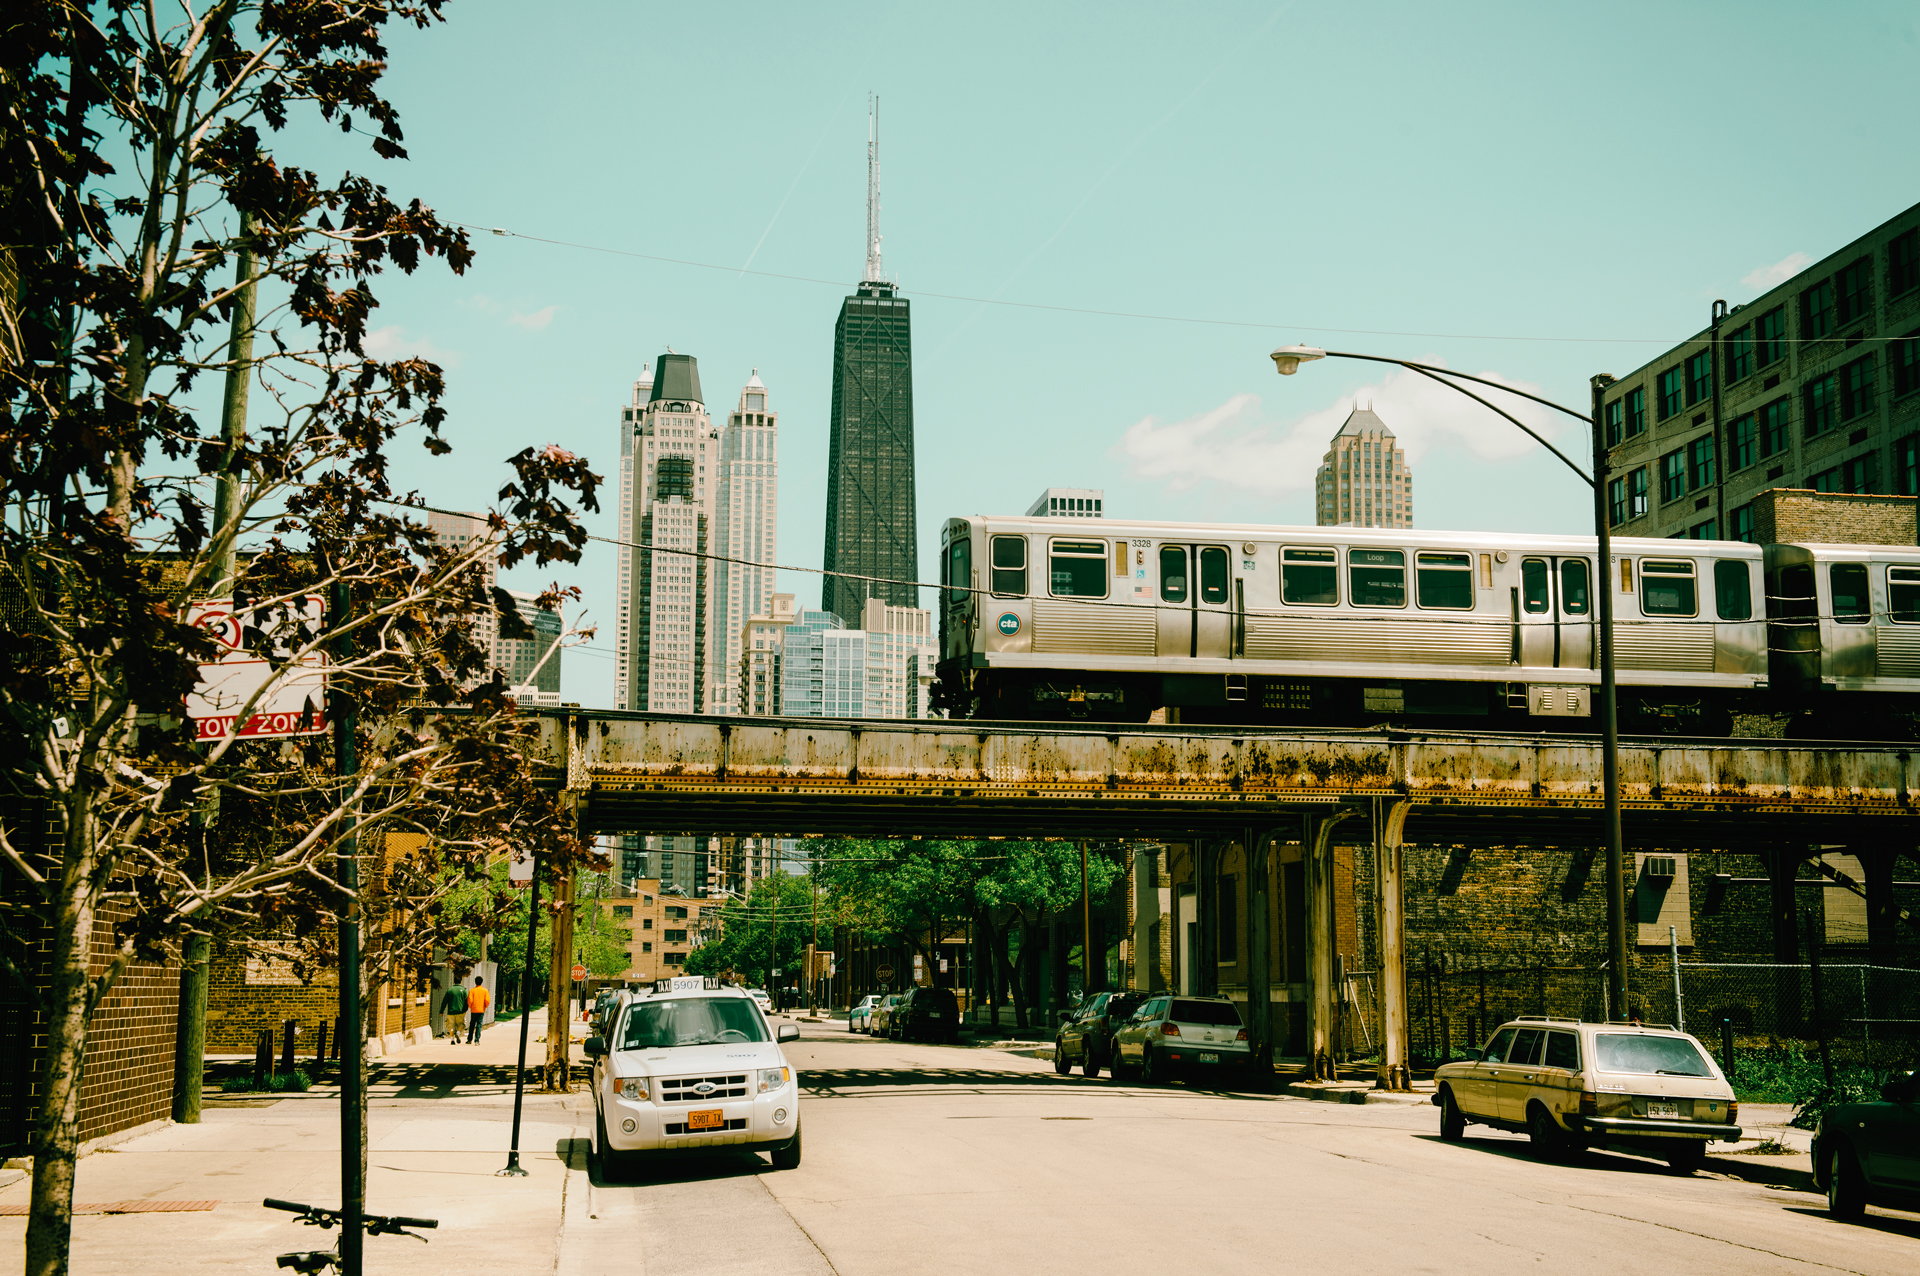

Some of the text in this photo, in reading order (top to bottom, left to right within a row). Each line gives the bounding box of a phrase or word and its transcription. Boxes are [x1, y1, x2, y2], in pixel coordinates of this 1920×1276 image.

[1132, 539, 1151, 548] 3328
[1367, 553, 1385, 562] Loop
[1000, 619, 1018, 628] cta
[571, 969, 586, 977] STOP
[878, 970, 894, 978] STOP
[656, 979, 671, 993] TAXI
[673, 980, 700, 990] 5907
[704, 977, 719, 989] TAXI
[693, 1114, 709, 1124] 5907
[713, 1113, 721, 1122] TX
